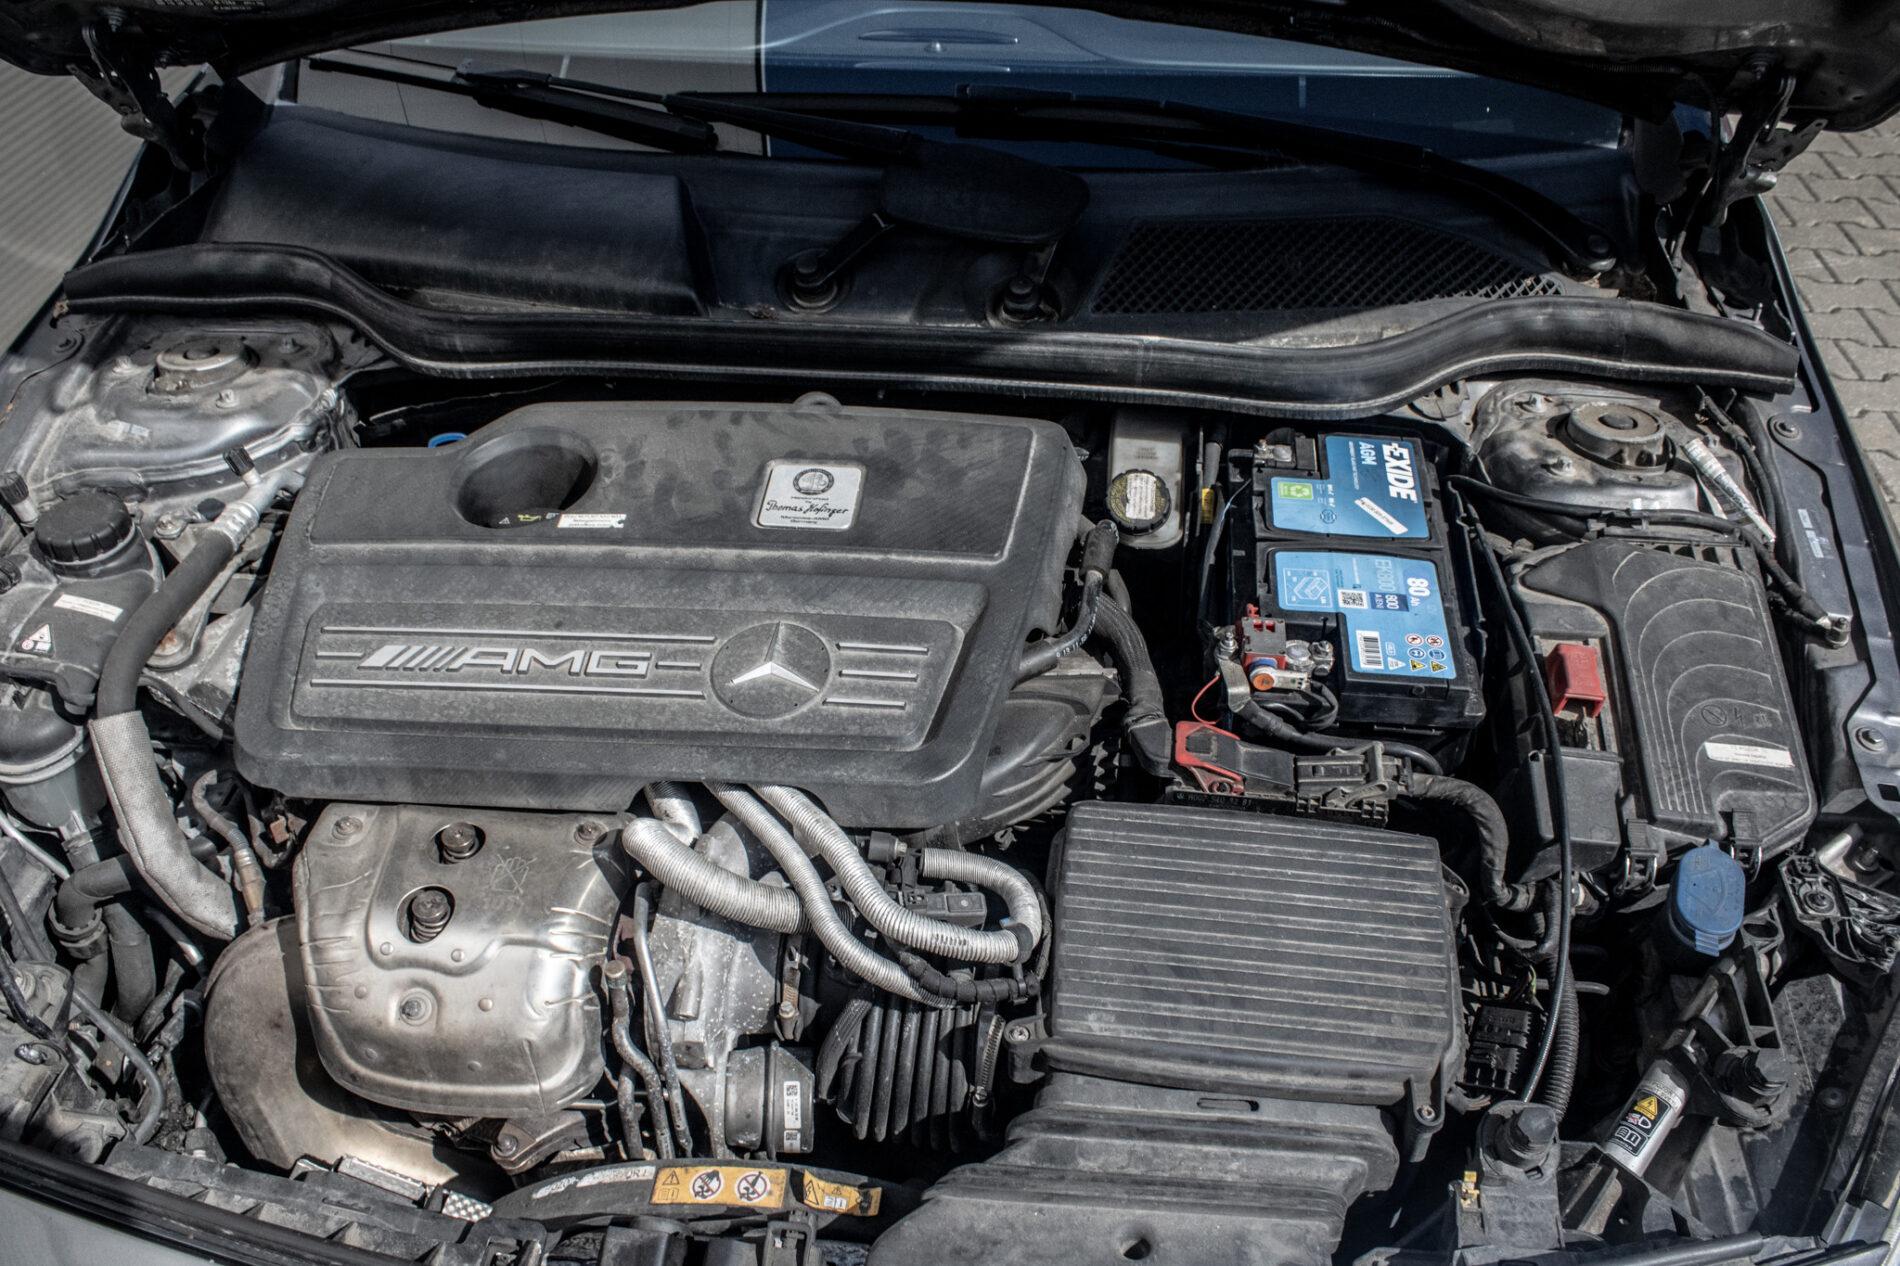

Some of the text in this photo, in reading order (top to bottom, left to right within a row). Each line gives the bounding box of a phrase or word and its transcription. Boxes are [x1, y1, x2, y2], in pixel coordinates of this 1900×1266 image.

[1359, 442, 1377, 465] AGM
[1382, 443, 1417, 503] EXIDE
[766, 500, 803, 511] Thomas
[1375, 560, 1396, 591] EK800
[1407, 577, 1430, 597] 80
[1385, 594, 1399, 609] 800
[446, 647, 653, 678] AMG
